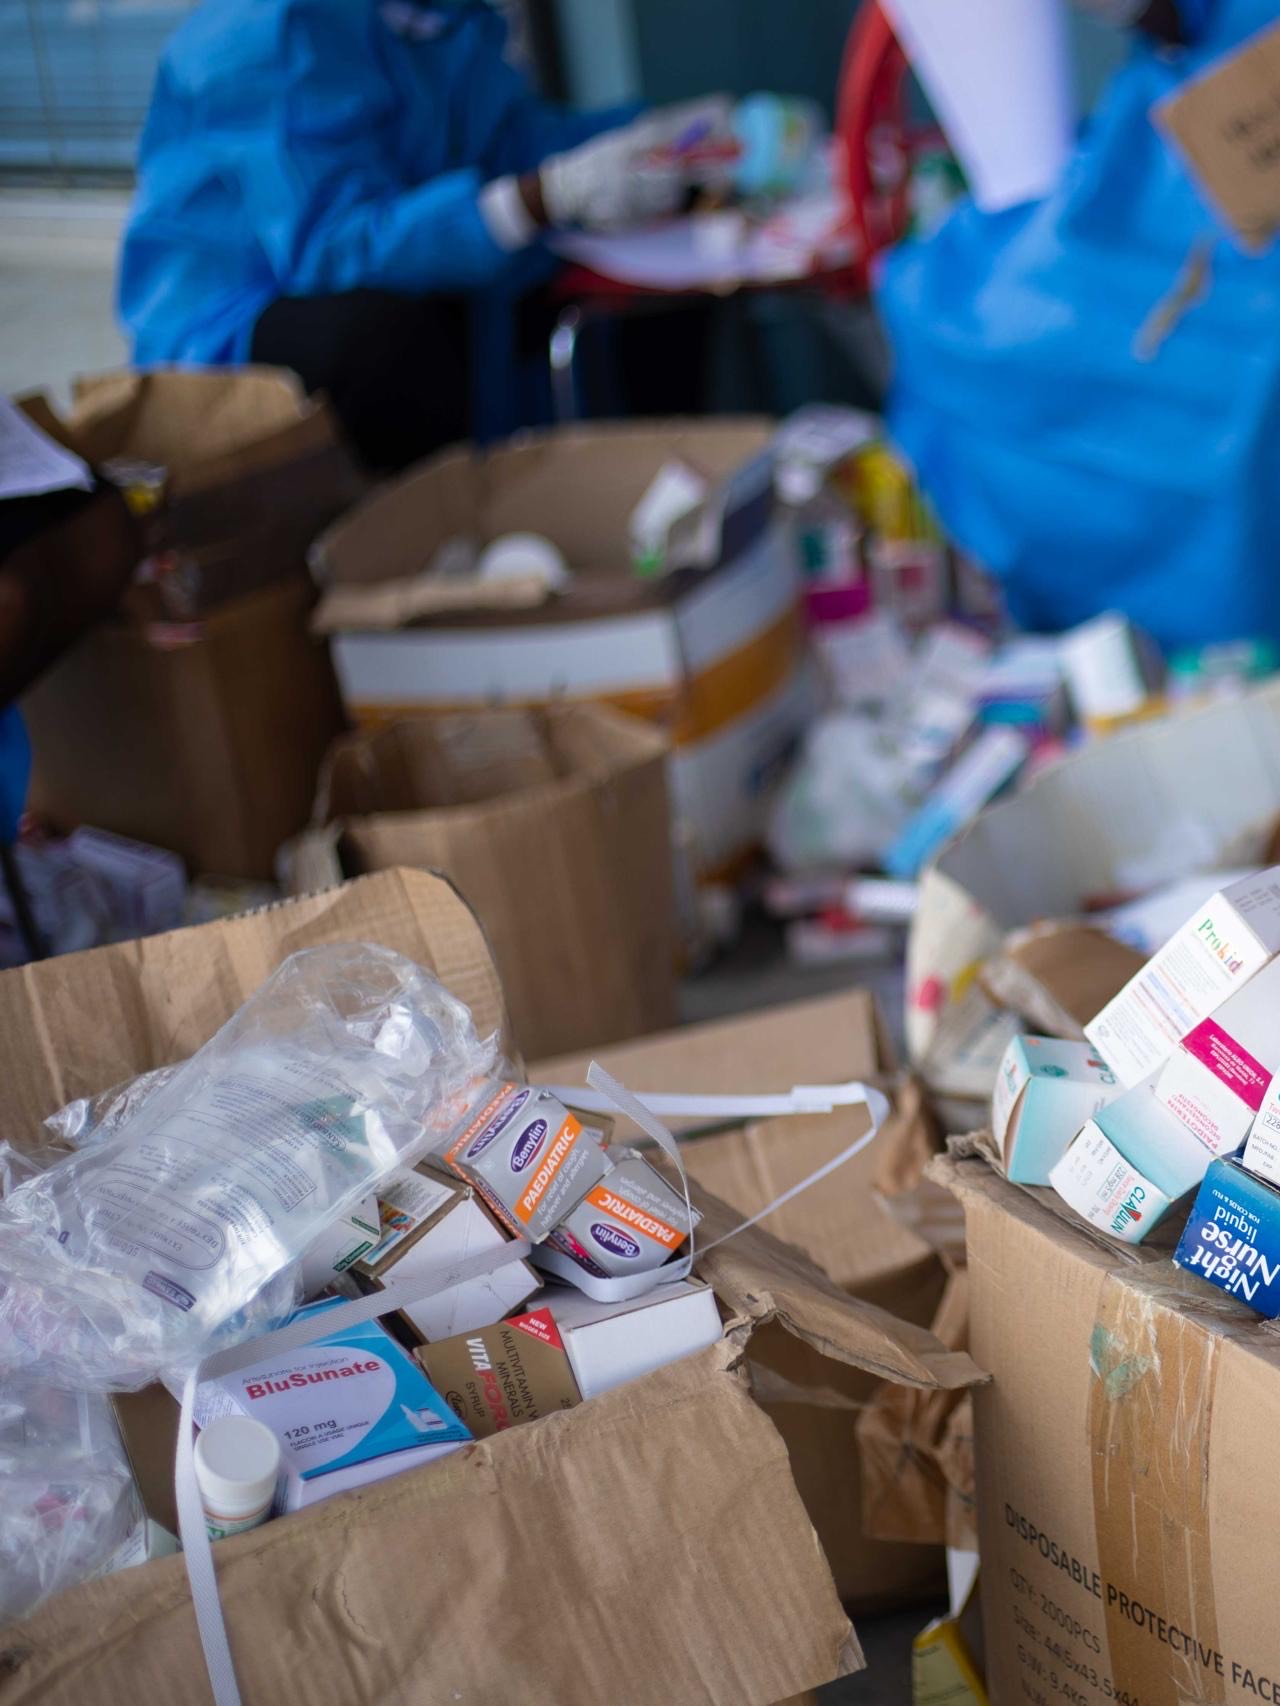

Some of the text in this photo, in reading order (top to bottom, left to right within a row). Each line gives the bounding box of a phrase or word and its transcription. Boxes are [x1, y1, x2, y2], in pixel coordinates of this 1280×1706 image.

[1198, 919, 1243, 974] Prokid
[513, 1123, 545, 1170] Benylin
[524, 1126, 575, 1211] PAEDIATRIC
[1110, 1186, 1146, 1234] CLAVULIN
[1210, 1188, 1224, 1199] FLU
[1227, 1199, 1249, 1216] COLDS
[598, 1194, 676, 1243] PAEDIATRIC
[1215, 1204, 1258, 1244] liquid
[1246, 1212, 1261, 1224] FOR
[594, 1225, 636, 1256] Benylin
[1200, 1221, 1280, 1287] Nurse
[1191, 1244, 1260, 1301] Night
[519, 1322, 538, 1336] BIGGER
[529, 1318, 548, 1330] NEW
[246, 1360, 380, 1400] BluSunate
[496, 1361, 524, 1418] MINERALS
[501, 1330, 534, 1409] MULTIVITAMIN
[466, 1382, 486, 1418] SYRUP
[283, 1418, 337, 1440] 120 mg
[1005, 1502, 1102, 1599] DISPOSABLE
[1106, 1582, 1225, 1678] PROTECTIVE
